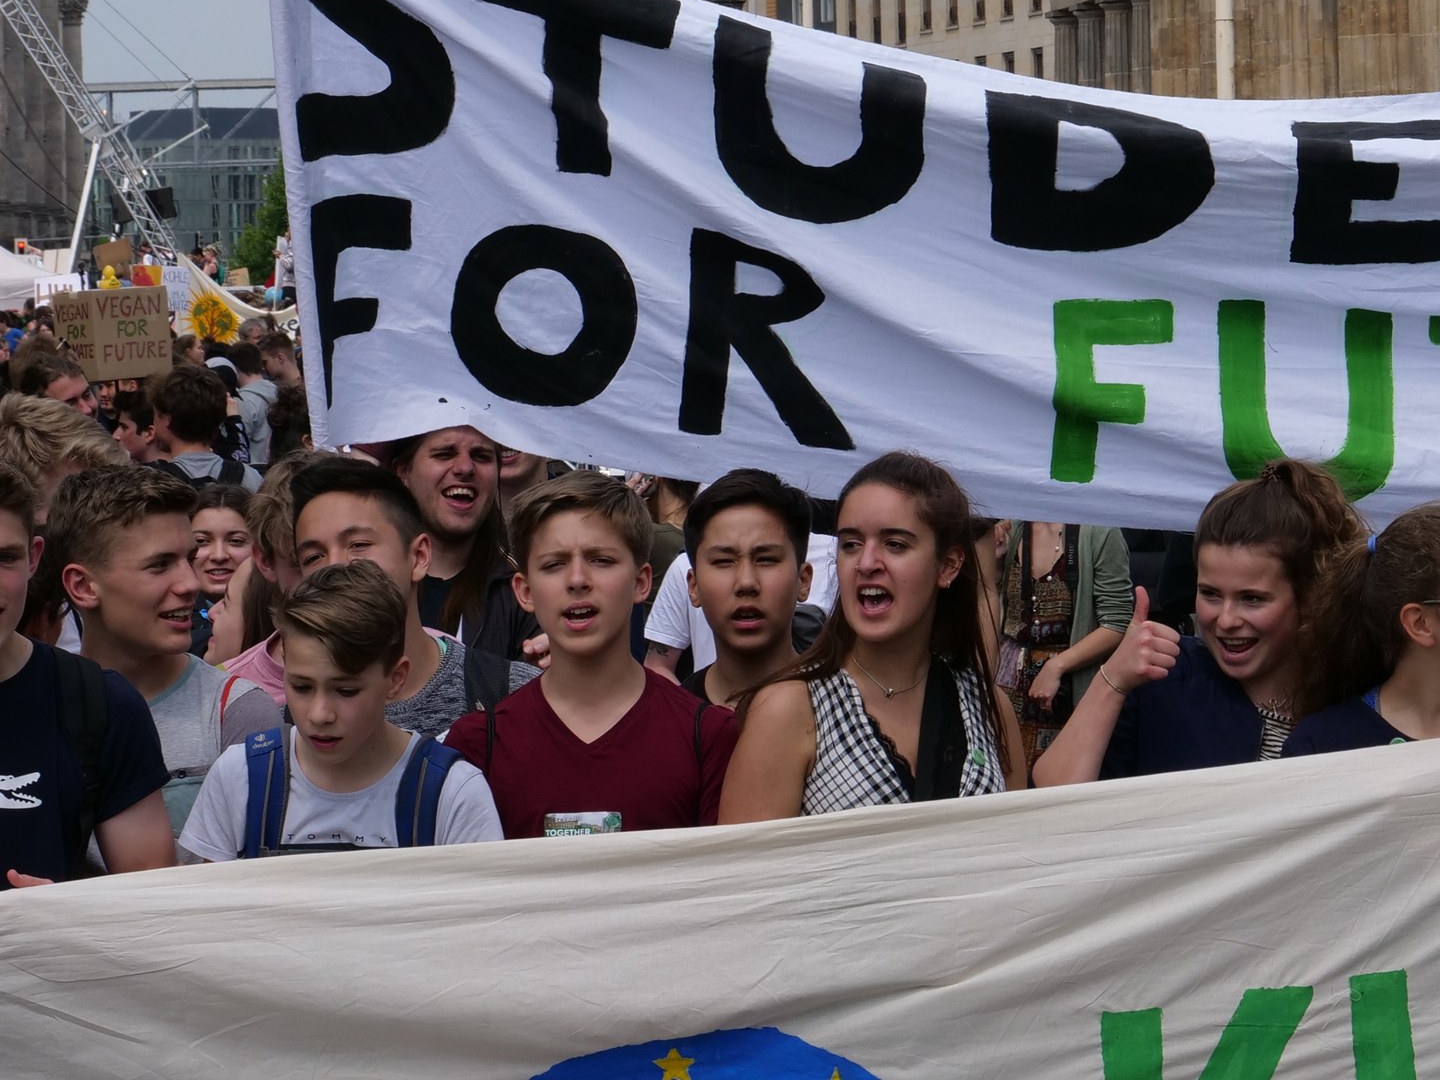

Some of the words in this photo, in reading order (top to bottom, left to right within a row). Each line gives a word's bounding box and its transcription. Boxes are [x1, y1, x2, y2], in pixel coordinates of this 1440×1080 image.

[54, 302, 89, 324] VEGAN
[96, 294, 161, 320] VEGAN
[117, 319, 149, 338] FOR
[310, 194, 855, 450] FOR
[67, 324, 87, 340] FOR
[71, 343, 95, 360] MATE
[103, 340, 168, 363] FUTURE
[287, 833, 387, 843] TOMMY
[544, 828, 592, 837] TOGETHER
